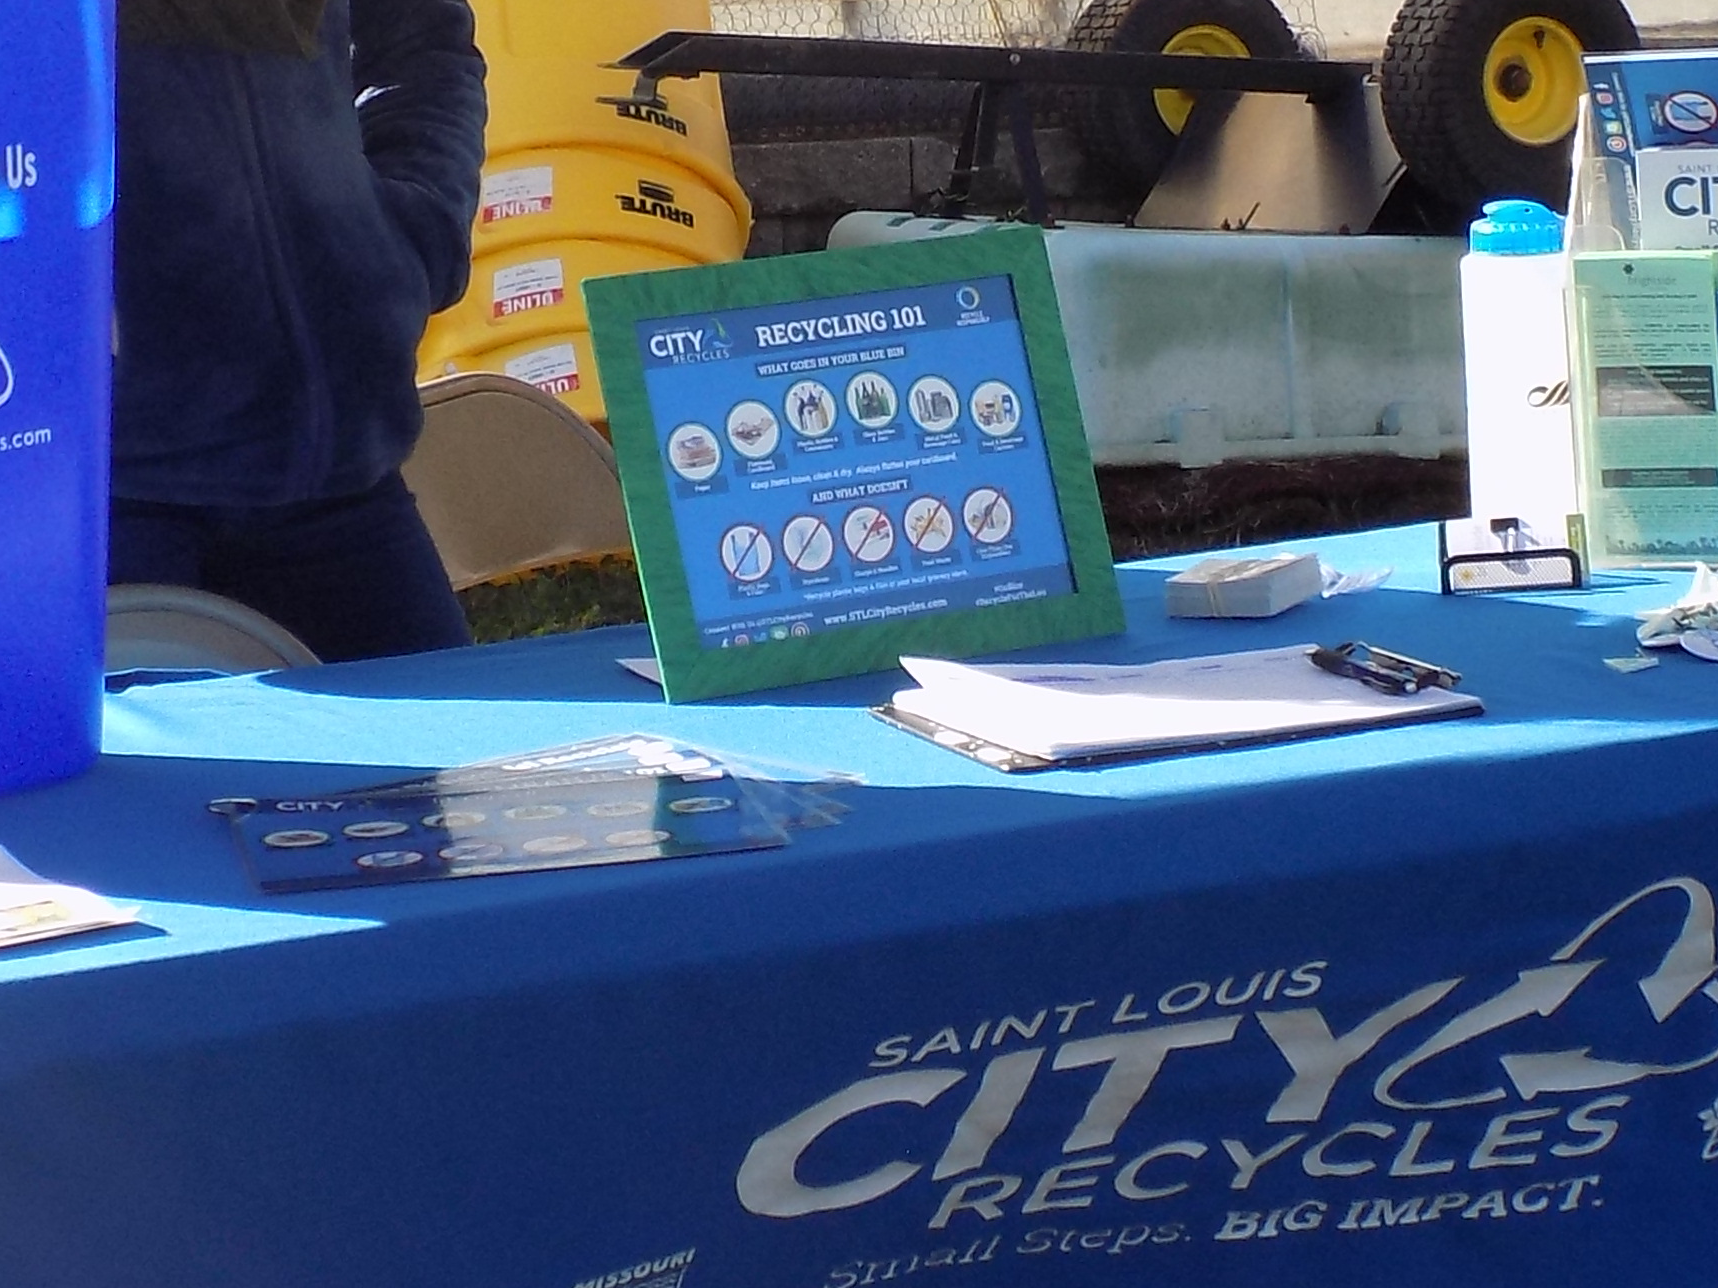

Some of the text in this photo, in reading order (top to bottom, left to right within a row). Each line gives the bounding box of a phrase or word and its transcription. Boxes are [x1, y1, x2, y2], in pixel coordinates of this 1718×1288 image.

[616, 102, 687, 137] BRUTE
[5, 143, 38, 189] Us
[1677, 163, 1712, 174] SAINT
[618, 195, 695, 229] BRUTE
[501, 291, 554, 315] ULINE
[649, 328, 704, 358] CITY
[755, 304, 927, 348] RECYCLING 101
[671, 349, 731, 365] RECYCLES
[757, 345, 906, 377] WHAT GOES IN YOUR BLUE BIN
[812, 490, 834, 504] AND
[834, 486, 865, 500] WHAT
[275, 800, 344, 812] CITY
[868, 959, 1329, 1068] SAINT LOUIS
[735, 975, 1465, 1218] CITY
[928, 1095, 1632, 1230] RECYCLES
[1016, 1220, 1193, 1256] Steps.
[1213, 1200, 1329, 1242] BIG
[1336, 1175, 1604, 1230] IMPACT.
